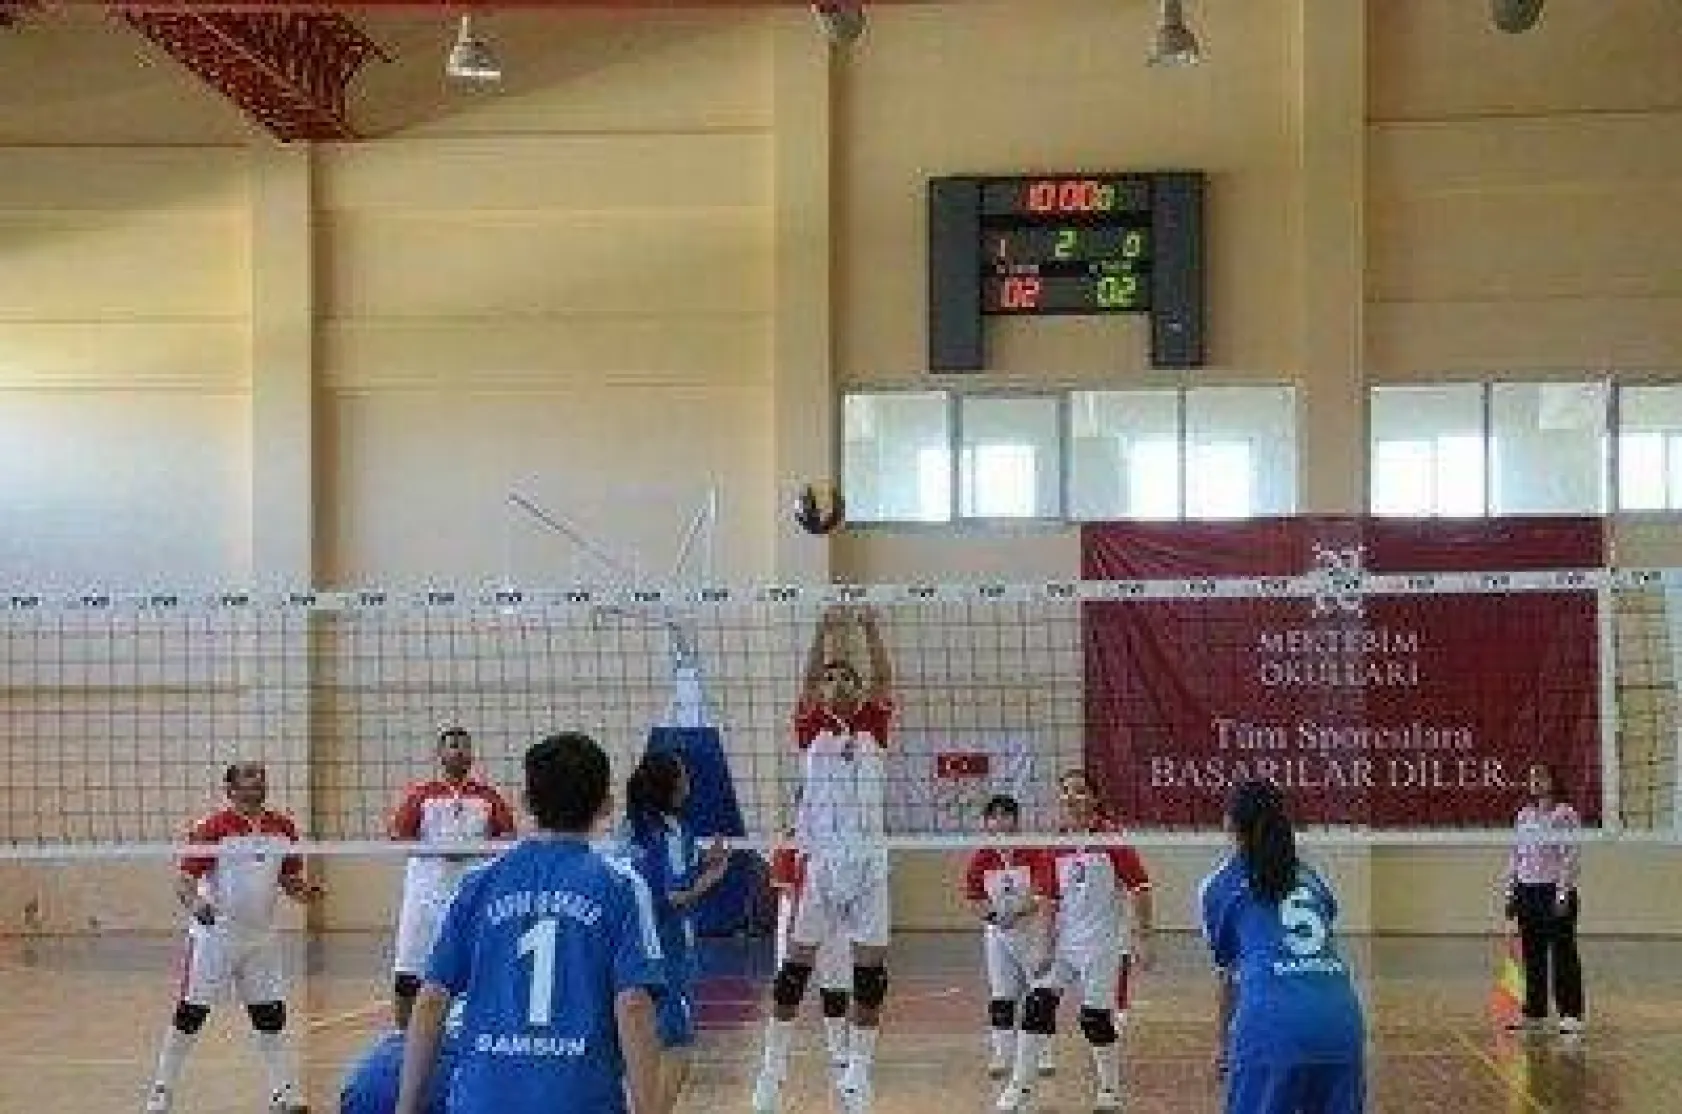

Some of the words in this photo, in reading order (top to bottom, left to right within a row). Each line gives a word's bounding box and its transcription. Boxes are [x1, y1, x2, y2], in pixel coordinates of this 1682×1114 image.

[1054, 231, 1078, 258] 2
[1121, 234, 1141, 258] 0
[1002, 277, 1040, 308] 02
[1096, 277, 1137, 308] 02
[1277, 886, 1327, 956] 5
[516, 920, 557, 1024] 1
